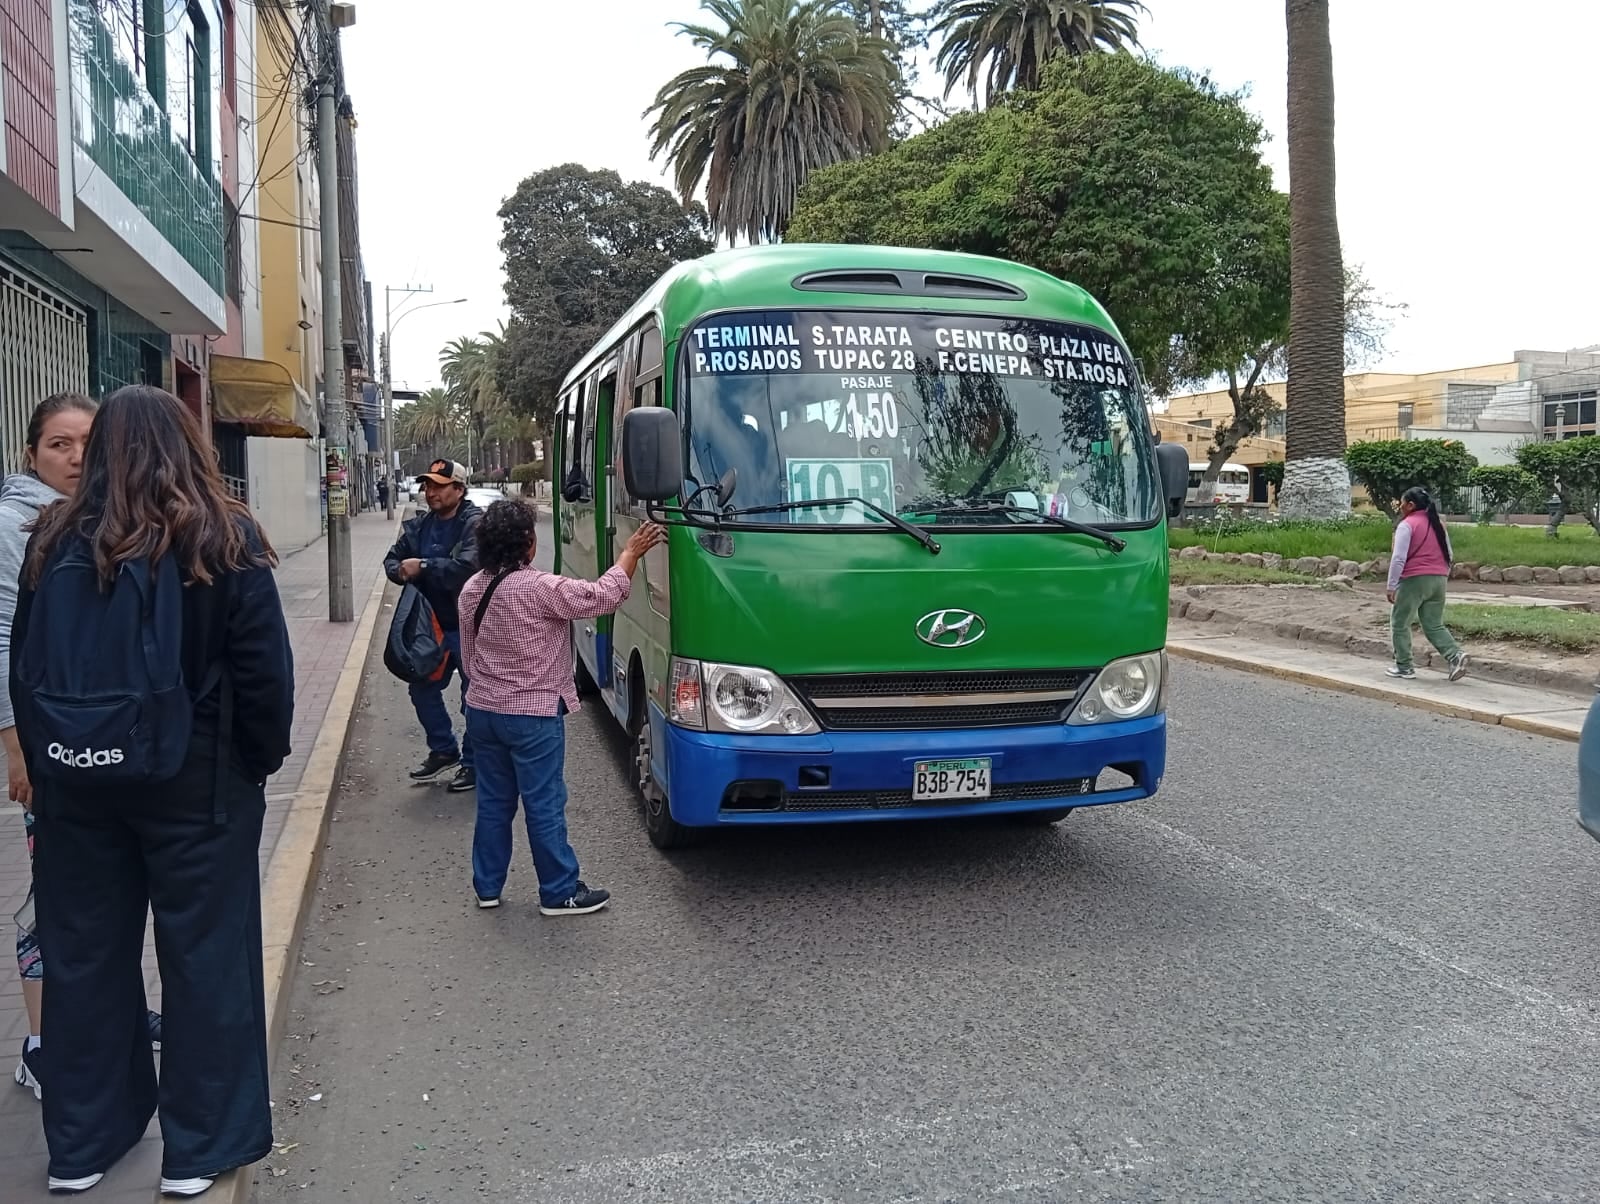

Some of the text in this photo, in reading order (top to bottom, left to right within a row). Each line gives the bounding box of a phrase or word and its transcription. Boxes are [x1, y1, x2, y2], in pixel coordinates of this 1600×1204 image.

[693, 325, 800, 348] TERMINAL
[812, 326, 913, 346] S.TARATA
[935, 328, 1028, 352] CENTRO
[695, 349, 802, 372] P.ROSADOS
[814, 350, 916, 370] TUPAC 28
[1039, 335, 1125, 365] PLAZA VEA
[938, 352, 1033, 376] F.CENEPA
[1043, 359, 1128, 387] STA.ROSA
[840, 376, 893, 389] PASAJE
[794, 463, 891, 525] 10-B
[47, 742, 124, 768] adidas
[940, 762, 966, 770] PERU
[917, 769, 987, 794] B3B-754
